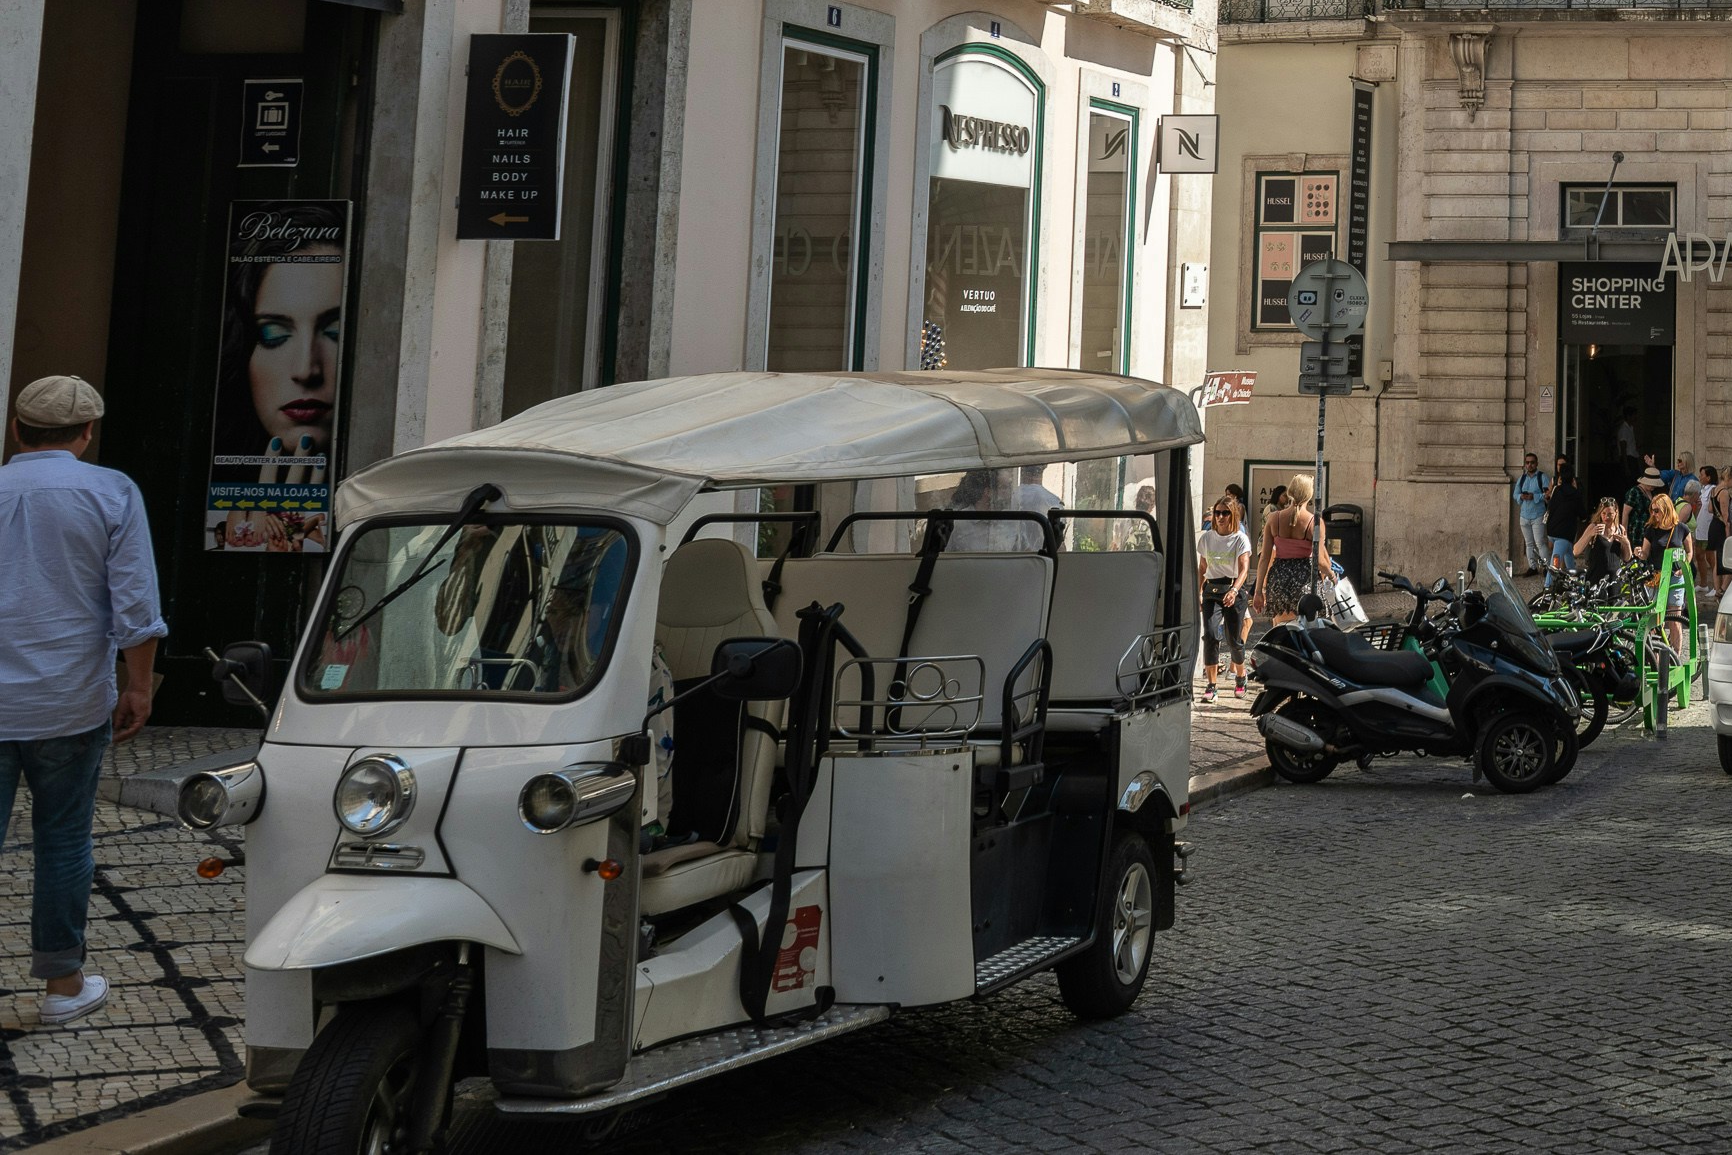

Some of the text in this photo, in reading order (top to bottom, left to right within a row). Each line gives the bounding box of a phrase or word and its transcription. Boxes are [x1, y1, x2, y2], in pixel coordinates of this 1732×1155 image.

[831, 8, 838, 25] 6
[497, 129, 529, 137] HAIR
[939, 104, 1030, 154] NESPRESSO
[492, 155, 531, 164] NAILS
[492, 173, 528, 182] BODY
[480, 191, 539, 199] MAKE UP
[1267, 196, 1292, 205] HUSSEL
[238, 211, 340, 252] Belezura
[1571, 277, 1665, 292] SHOPPING
[963, 289, 996, 301] VERTUO
[1571, 294, 1642, 309] CENTER
[215, 456, 242, 464] BEAUTY
[243, 456, 270, 464] CENTER
[211, 487, 328, 497] VISITE-NOS NA LOJA 3-D
